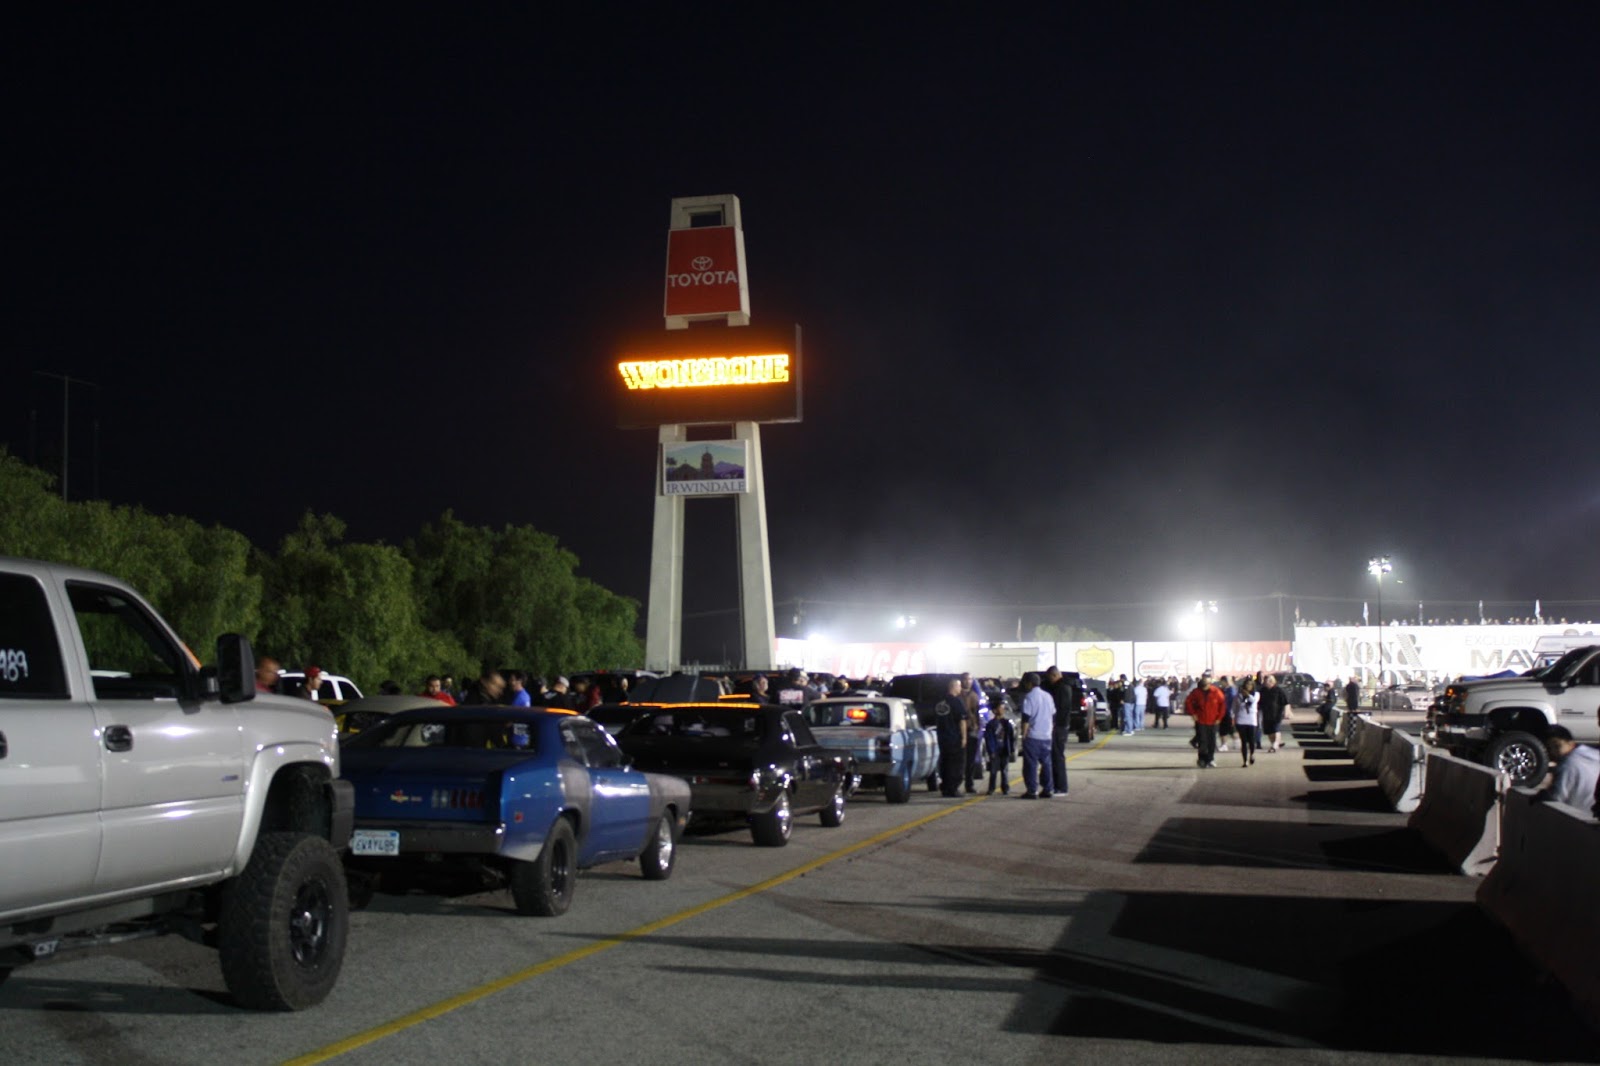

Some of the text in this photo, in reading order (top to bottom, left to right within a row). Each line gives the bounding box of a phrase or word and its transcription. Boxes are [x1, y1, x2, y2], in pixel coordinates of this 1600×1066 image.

[668, 270, 738, 288] TOYOTA
[667, 480, 745, 493] IRWINDALE
[838, 649, 924, 677] LUCAS
[1214, 652, 1288, 671] UCAS OIL
